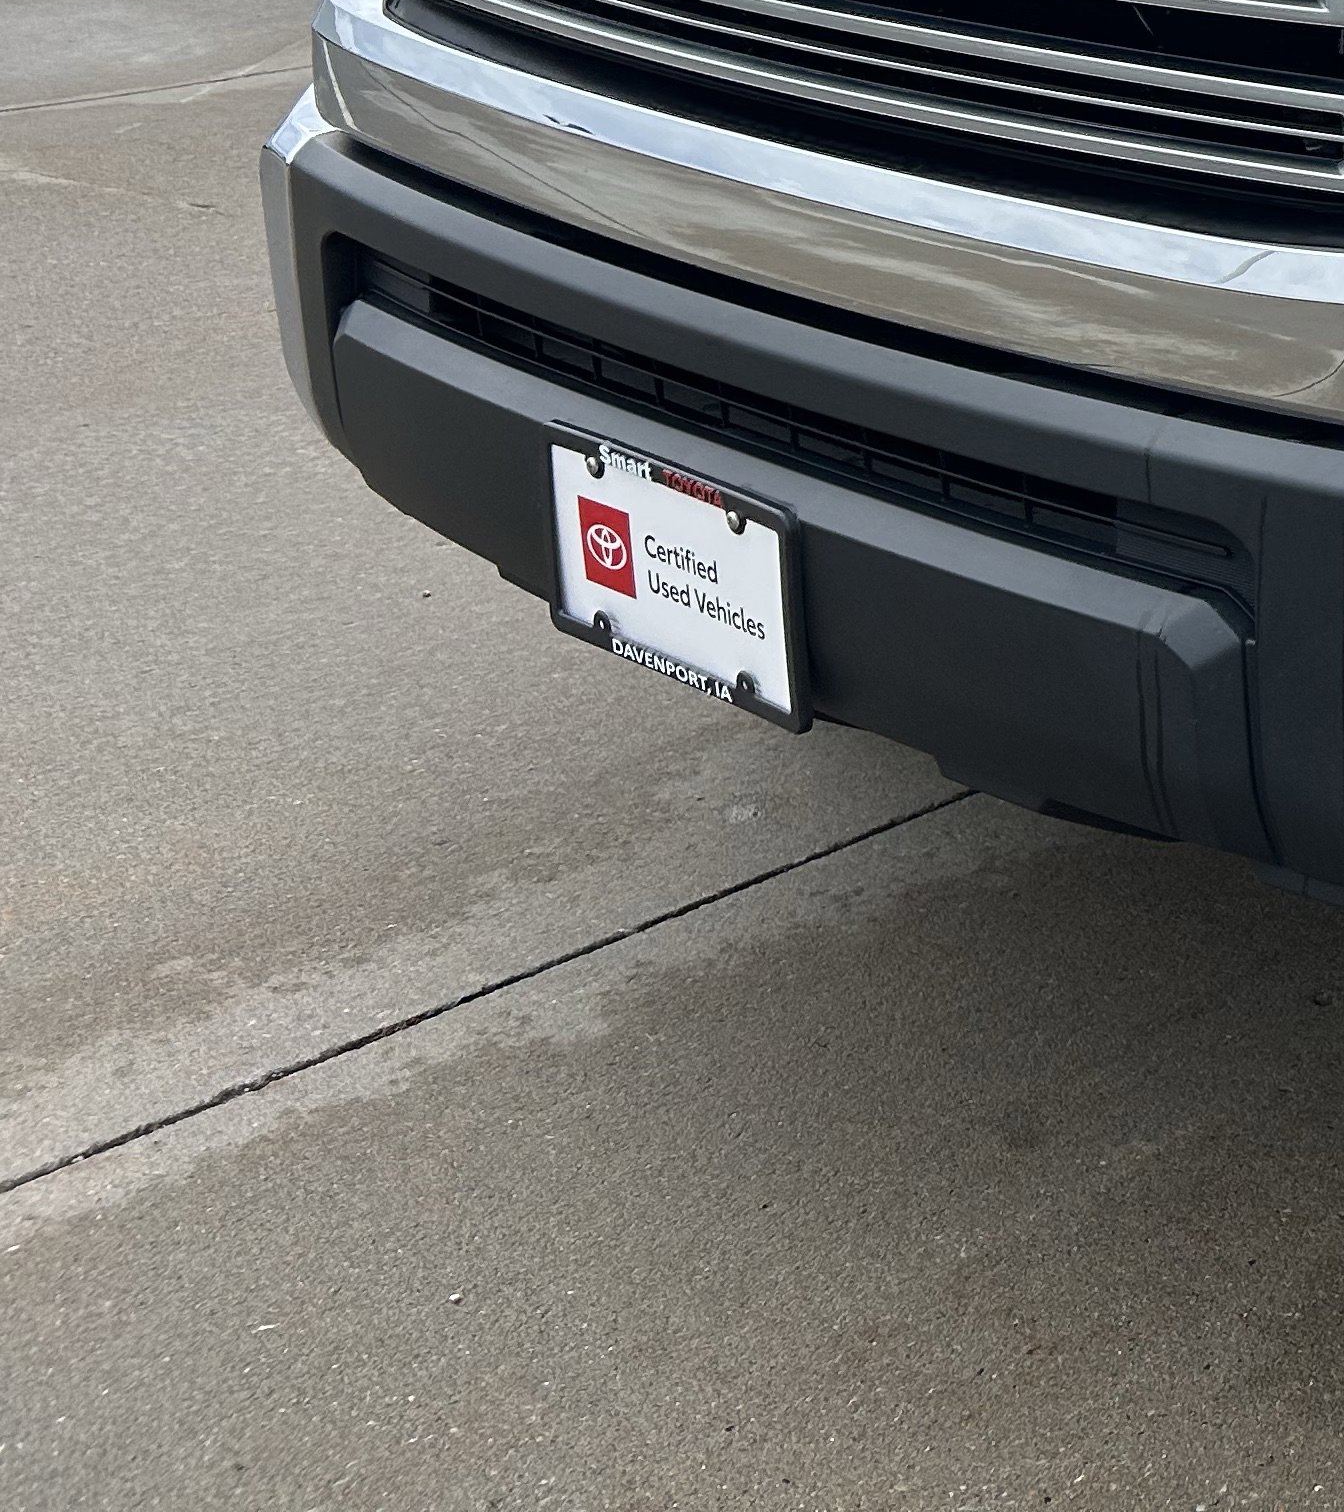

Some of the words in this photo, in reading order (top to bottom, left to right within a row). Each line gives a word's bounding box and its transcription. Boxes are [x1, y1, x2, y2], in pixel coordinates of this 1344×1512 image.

[598, 445, 651, 481] Smart
[662, 468, 723, 509] TOYOTA
[644, 535, 718, 585] Certified
[648, 569, 691, 608] Used
[694, 588, 765, 640] Vehicles
[612, 639, 712, 697] DAVENPORT,
[714, 684, 733, 704] IA
